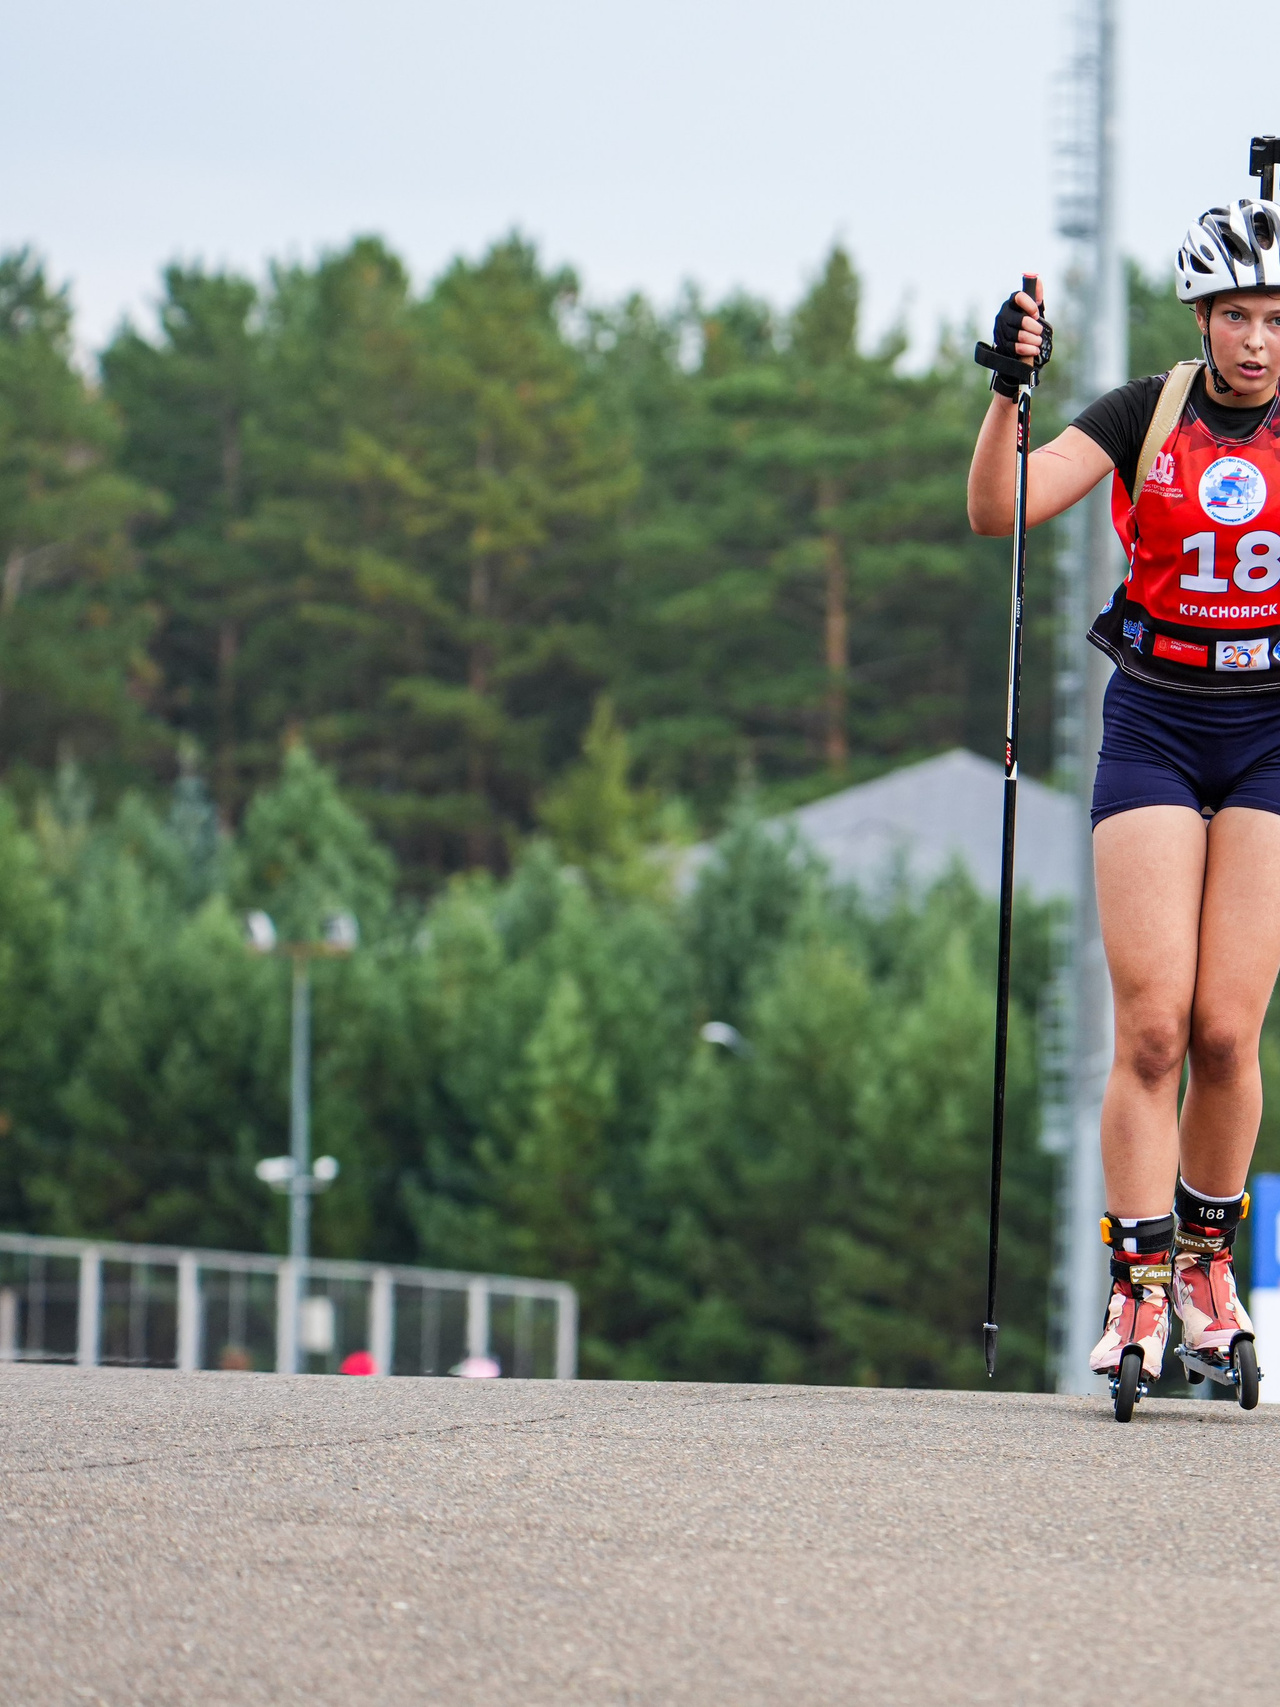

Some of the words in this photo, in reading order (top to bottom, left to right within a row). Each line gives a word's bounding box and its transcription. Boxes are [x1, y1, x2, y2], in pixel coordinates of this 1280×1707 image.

[1179, 603, 1278, 618] КРАСНОЯРСК
[1198, 1206, 1225, 1220] 168
[1175, 1235, 1205, 1248] alpina
